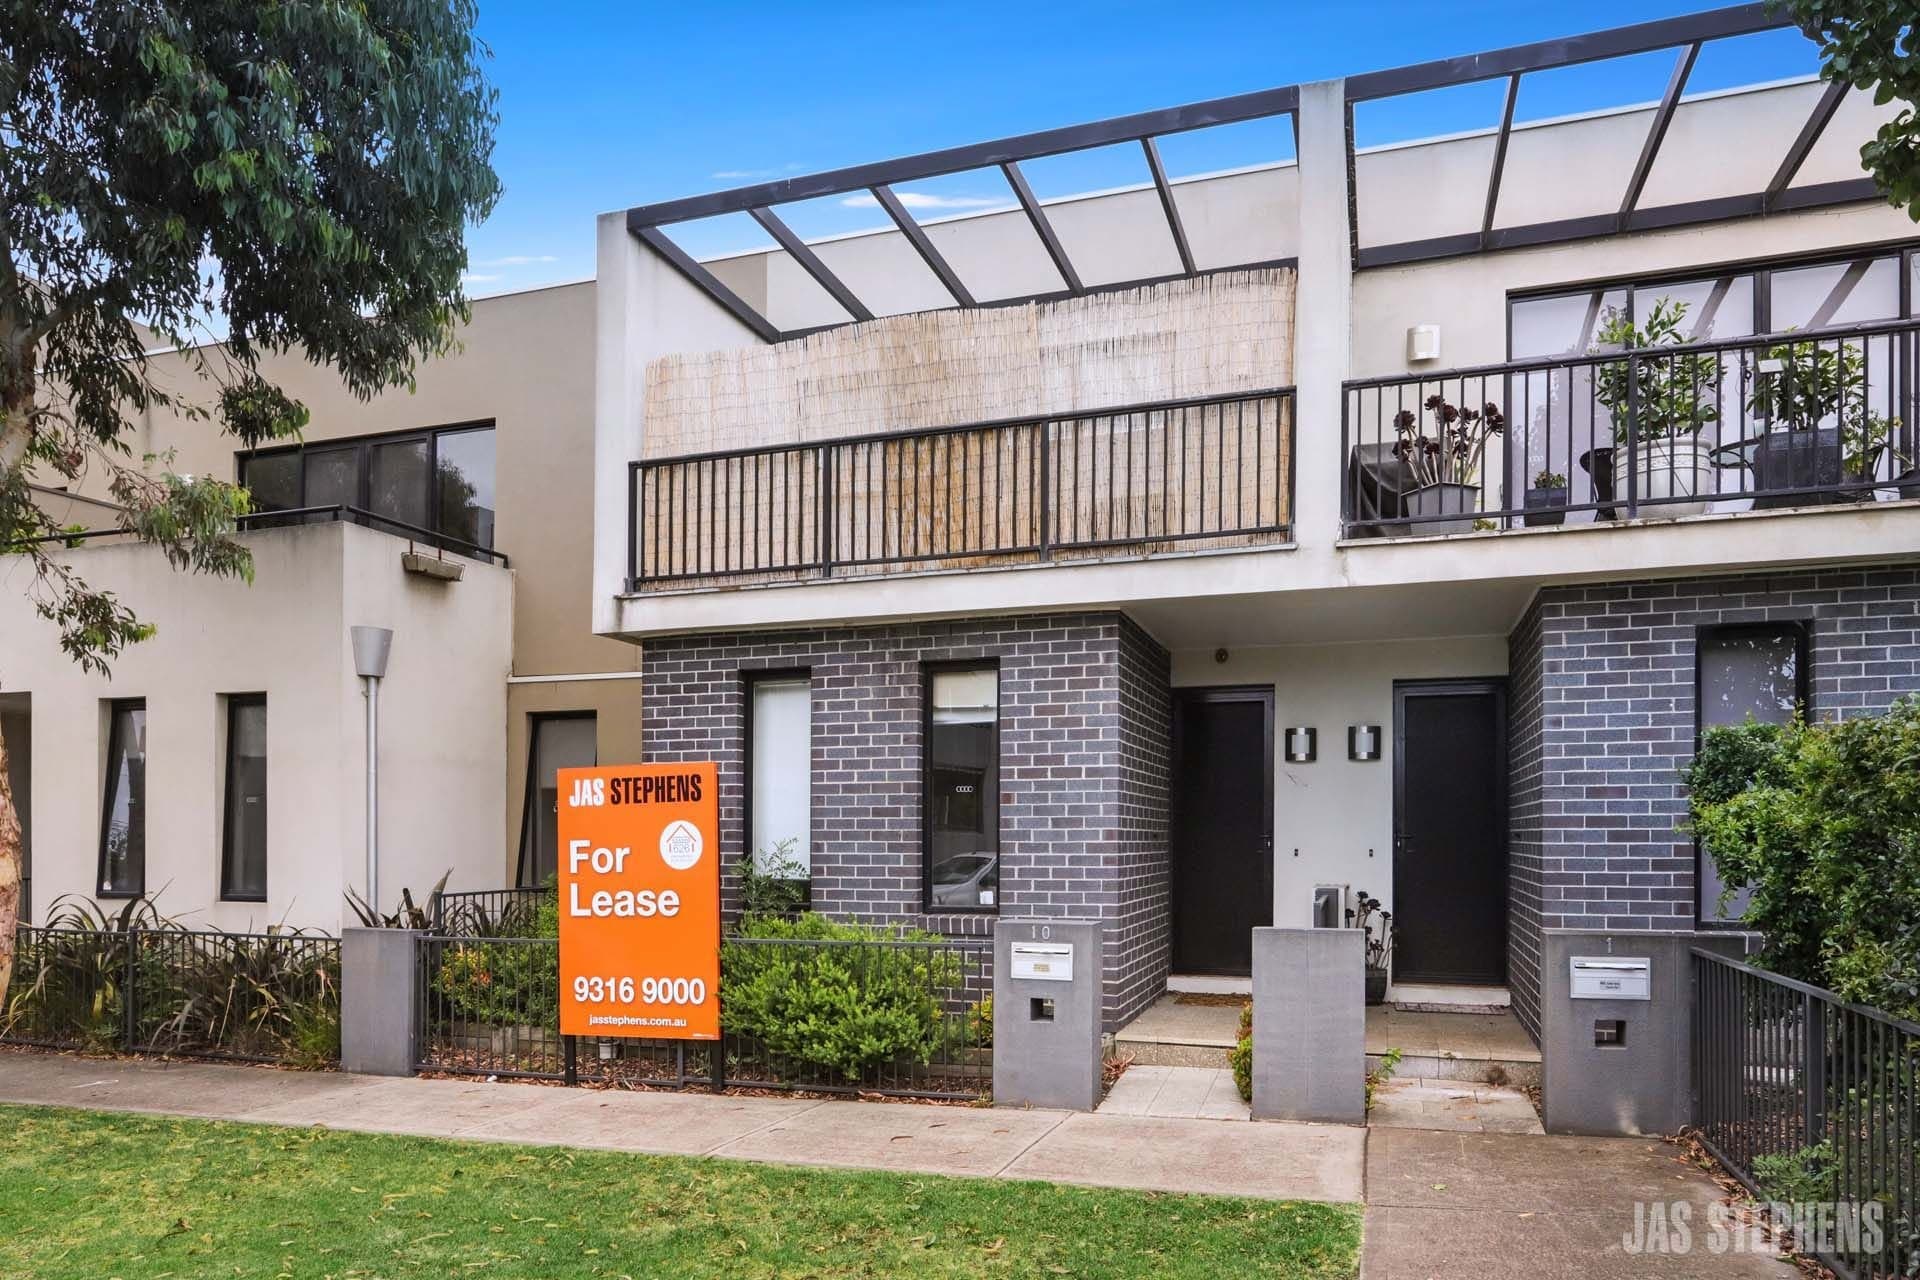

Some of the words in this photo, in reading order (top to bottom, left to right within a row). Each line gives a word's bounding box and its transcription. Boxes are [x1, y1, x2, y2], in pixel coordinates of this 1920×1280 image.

[569, 778, 605, 807] JAS
[610, 774, 702, 805] STEPHENS
[569, 839, 631, 874] For
[569, 882, 680, 917] Lease
[573, 976, 635, 1004] 9316
[641, 977, 706, 1005] 9000
[588, 1014, 688, 1027] jasstephens.com.au
